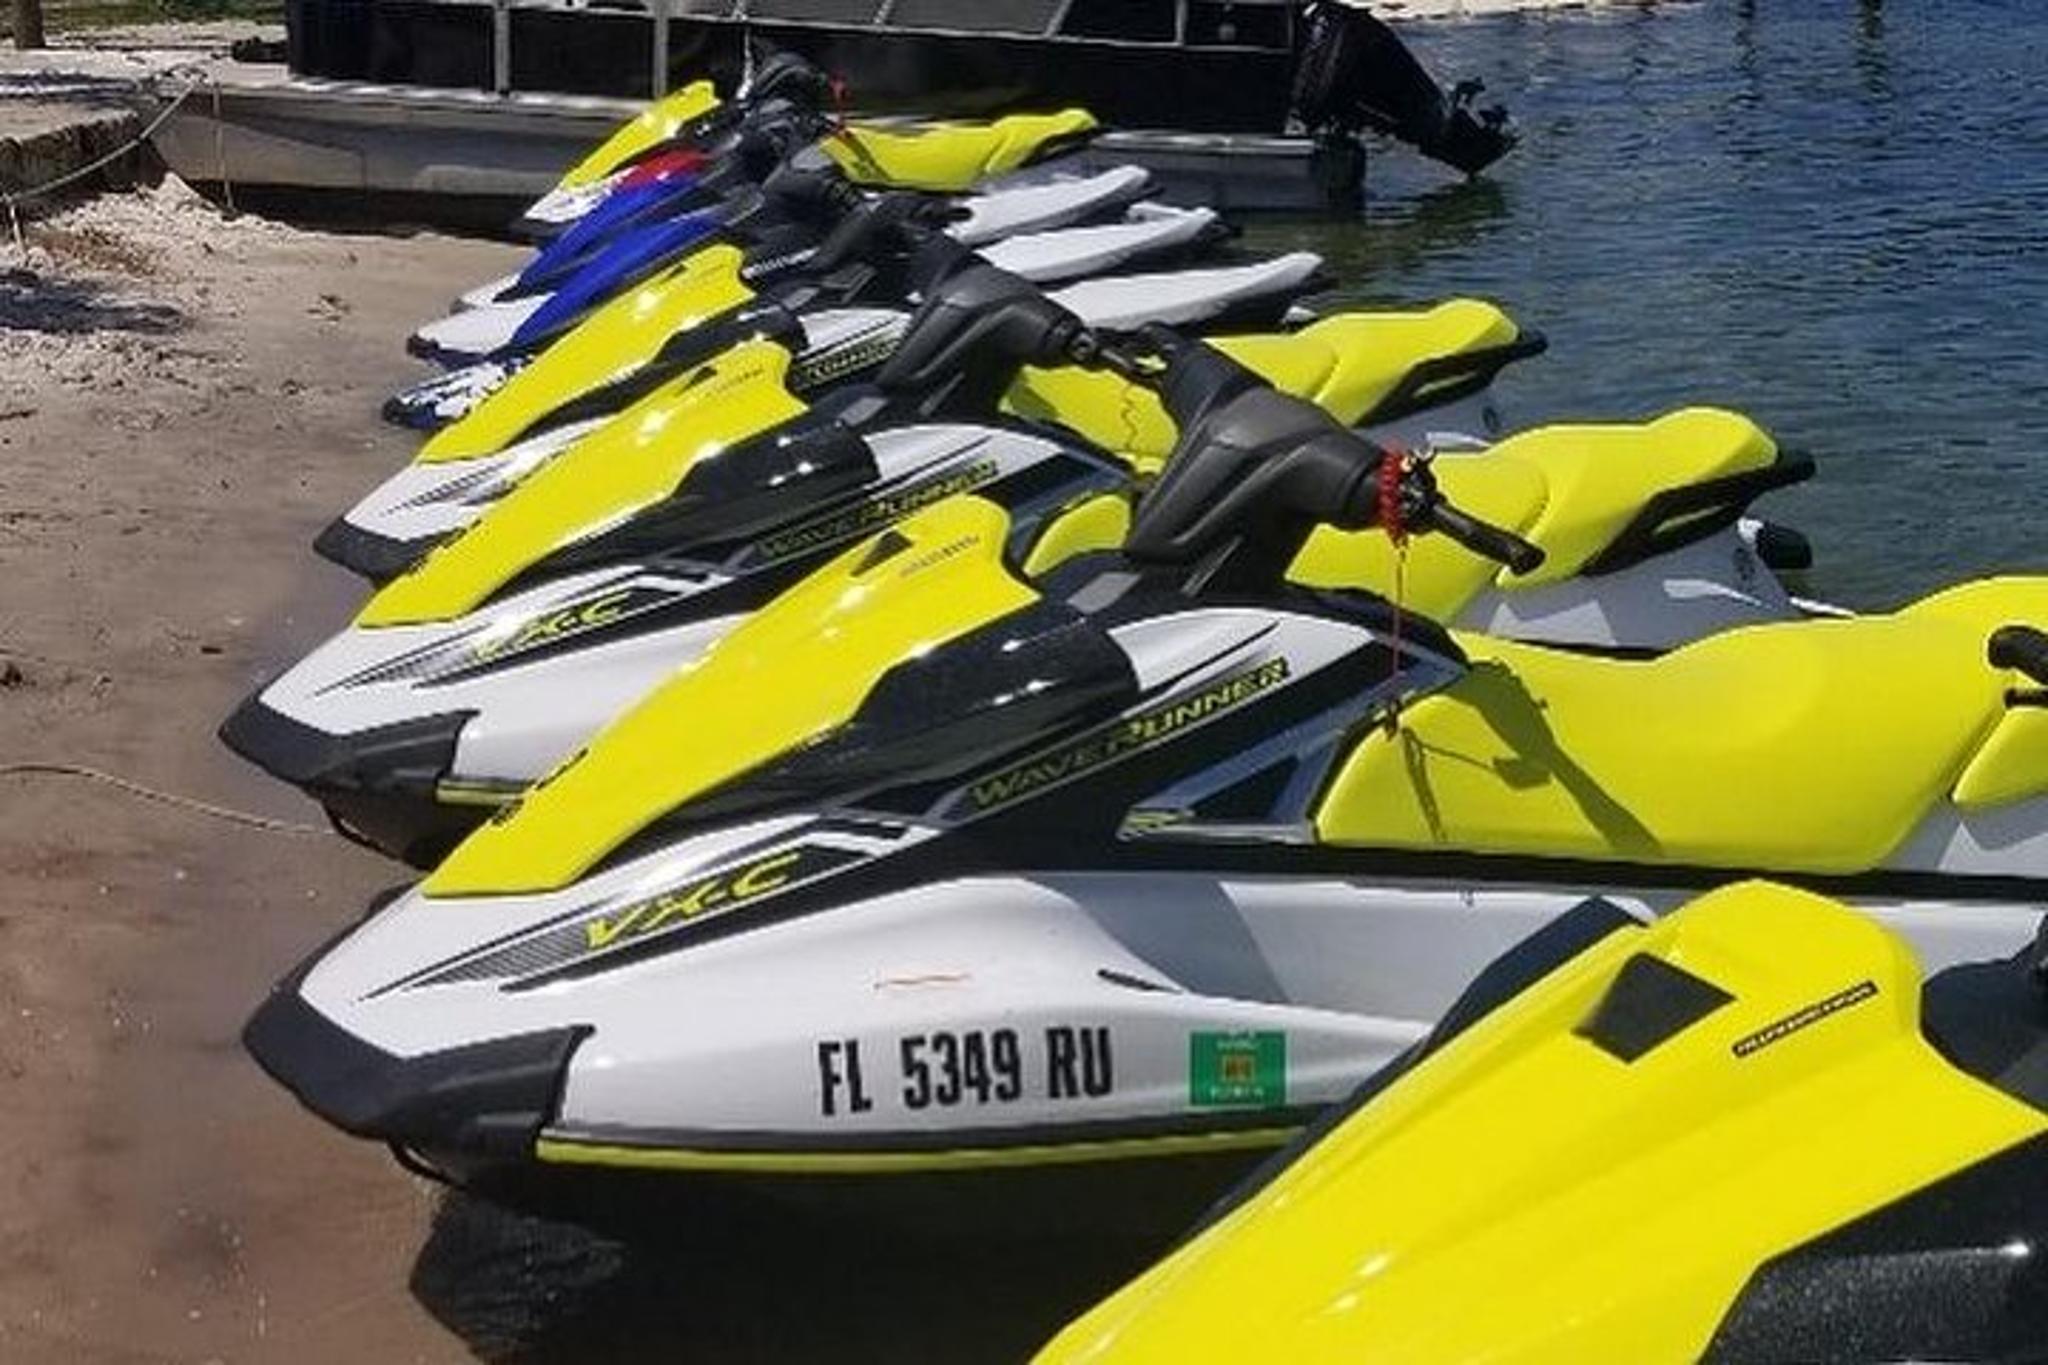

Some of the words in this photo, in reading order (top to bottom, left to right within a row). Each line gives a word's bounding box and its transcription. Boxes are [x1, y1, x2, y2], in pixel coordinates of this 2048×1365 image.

[817, 1038, 873, 1116] FL
[901, 1028, 1022, 1110] 5349
[1046, 1026, 1114, 1099] RU
